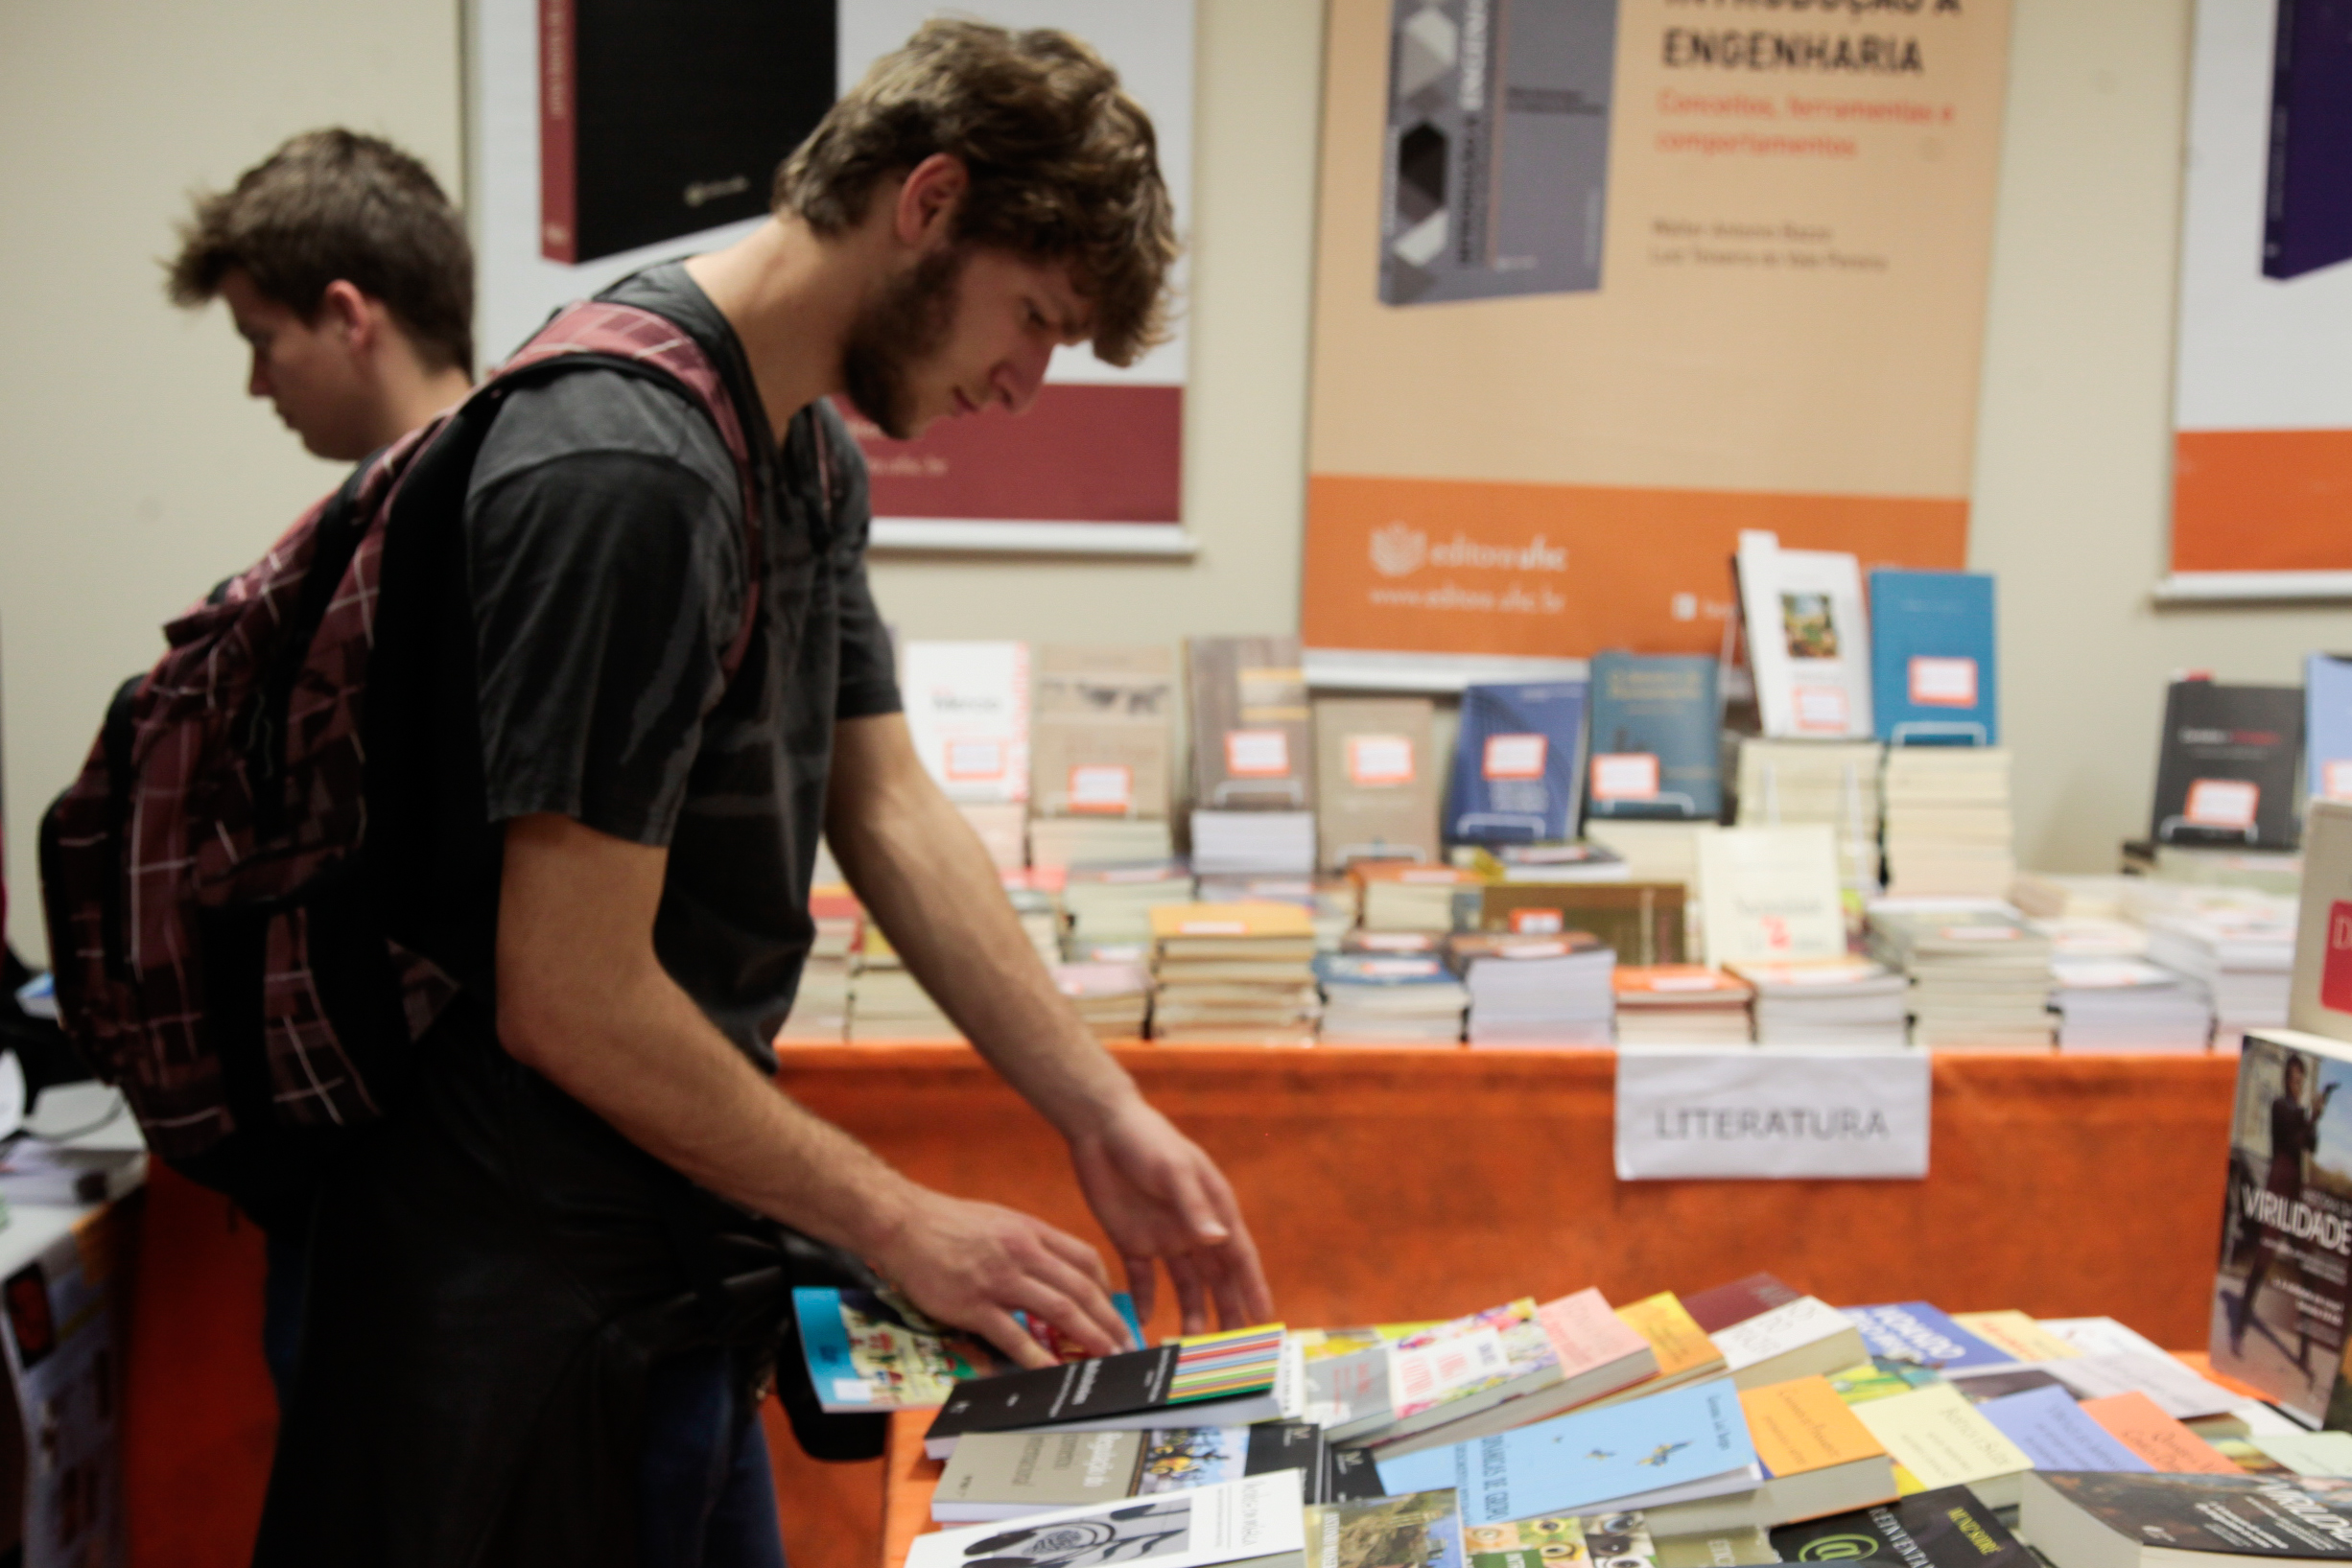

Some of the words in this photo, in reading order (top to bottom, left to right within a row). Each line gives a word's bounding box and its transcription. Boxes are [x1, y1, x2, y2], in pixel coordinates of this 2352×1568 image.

[1662, 26, 1924, 76] ENGENHARIA
[1786, 94, 1932, 126] ferramentas
[1656, 130, 1858, 158] comportamentos
[1655, 1106, 1891, 1141] LITERATURA
[2241, 1184, 2352, 1257] VIRILIDADE
[1947, 1507, 1981, 1535] MUNIZ
[1968, 1529, 2004, 1556] SODRÉ
